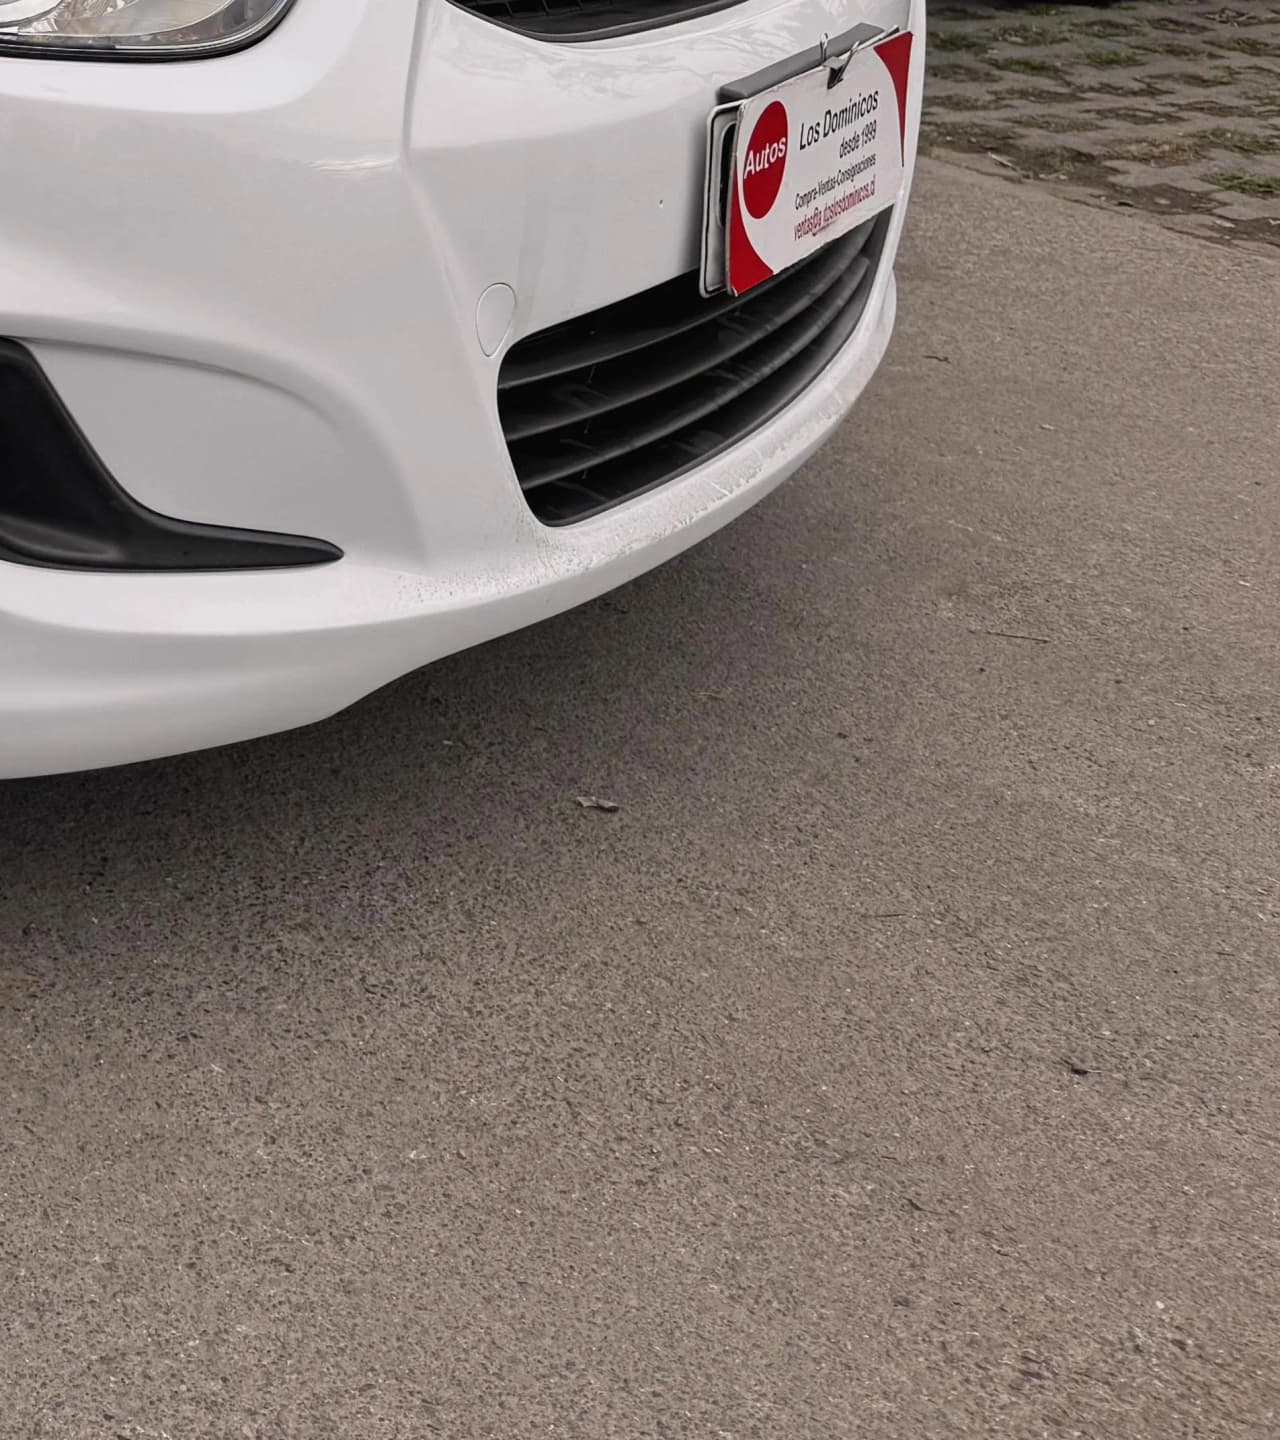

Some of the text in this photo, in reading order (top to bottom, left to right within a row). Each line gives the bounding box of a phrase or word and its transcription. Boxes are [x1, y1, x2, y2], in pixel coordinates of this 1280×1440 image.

[799, 90, 879, 151] Los Dominicos
[839, 119, 877, 159] desde 1999
[743, 136, 787, 180] Autos
